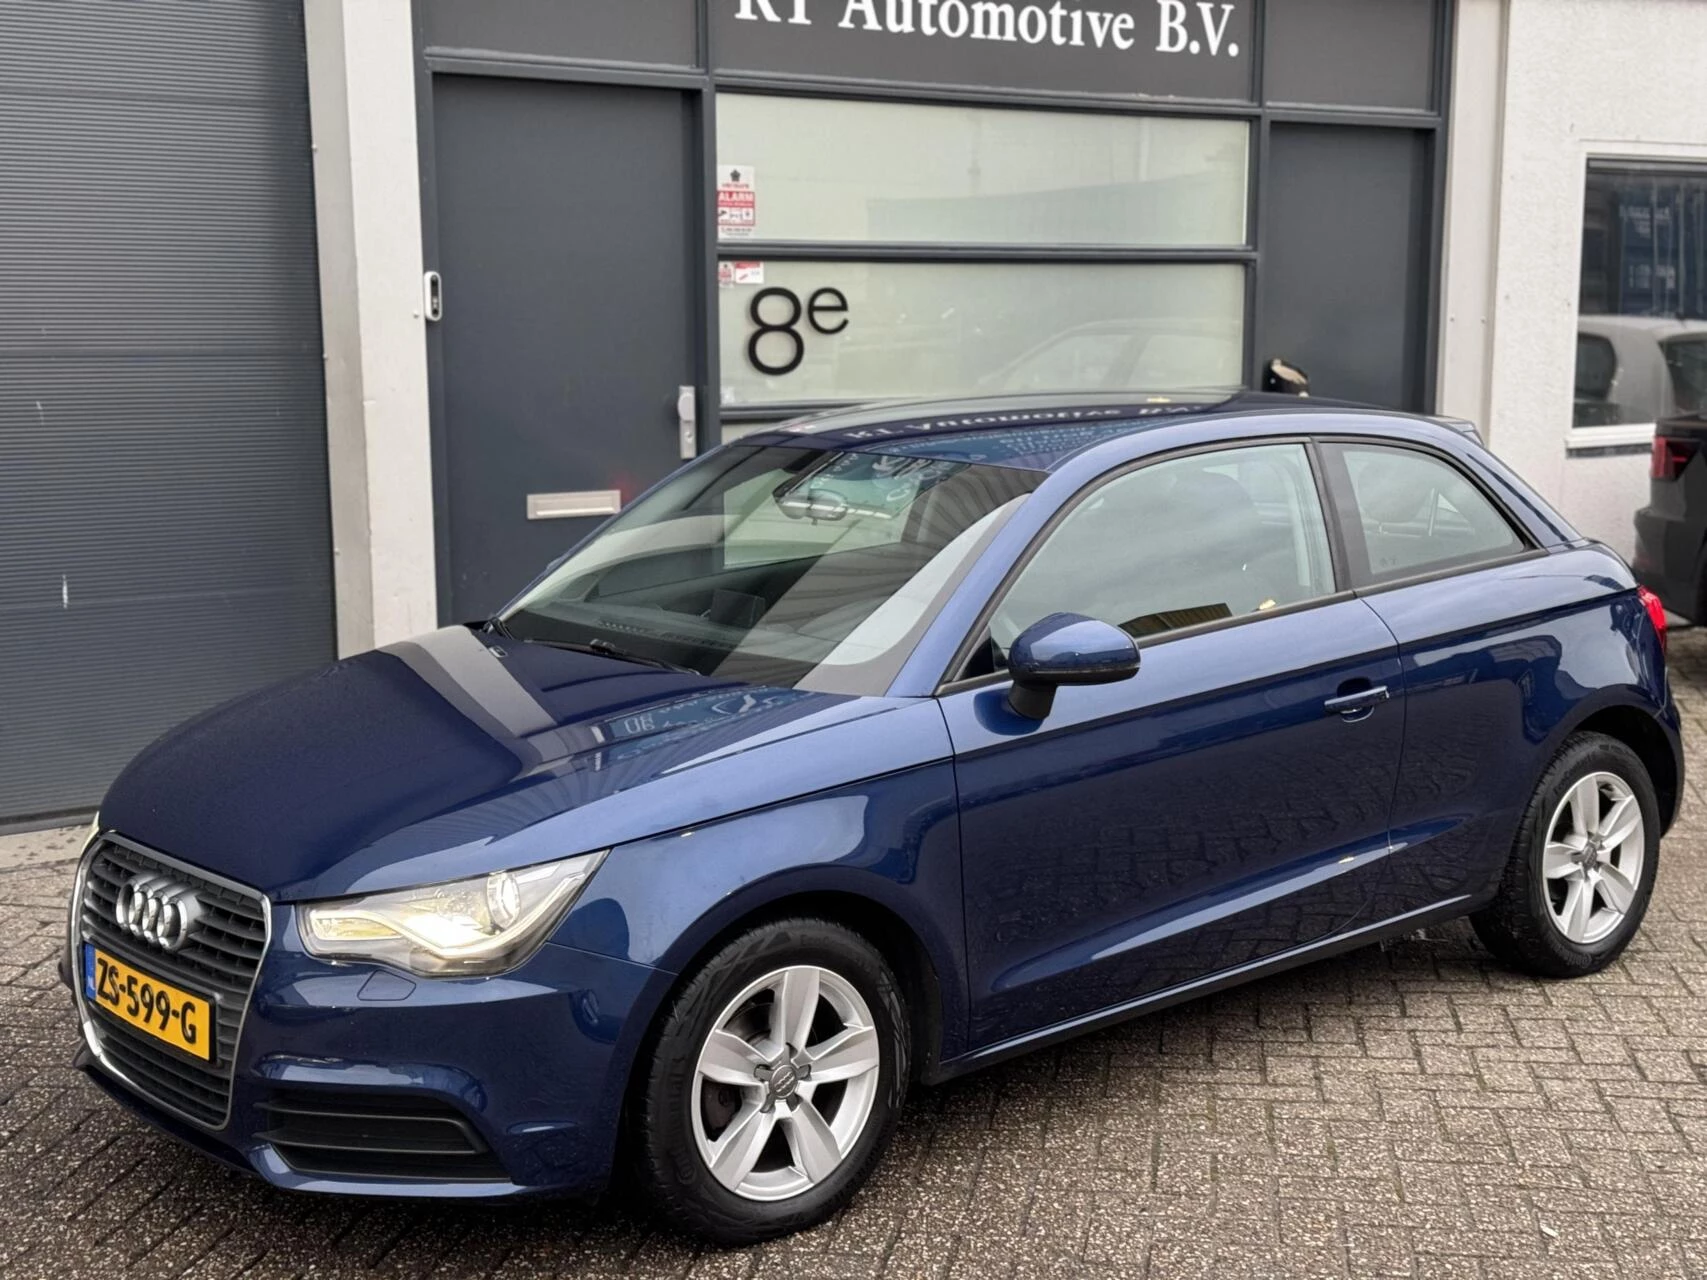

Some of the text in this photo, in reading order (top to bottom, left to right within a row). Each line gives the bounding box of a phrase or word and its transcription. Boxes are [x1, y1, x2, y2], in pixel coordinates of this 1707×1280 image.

[838, 0, 1135, 50] Automotive
[1155, 0, 1240, 57] B.V.
[718, 191, 754, 201] ALARM
[97, 957, 197, 1045] ZS-599-G
